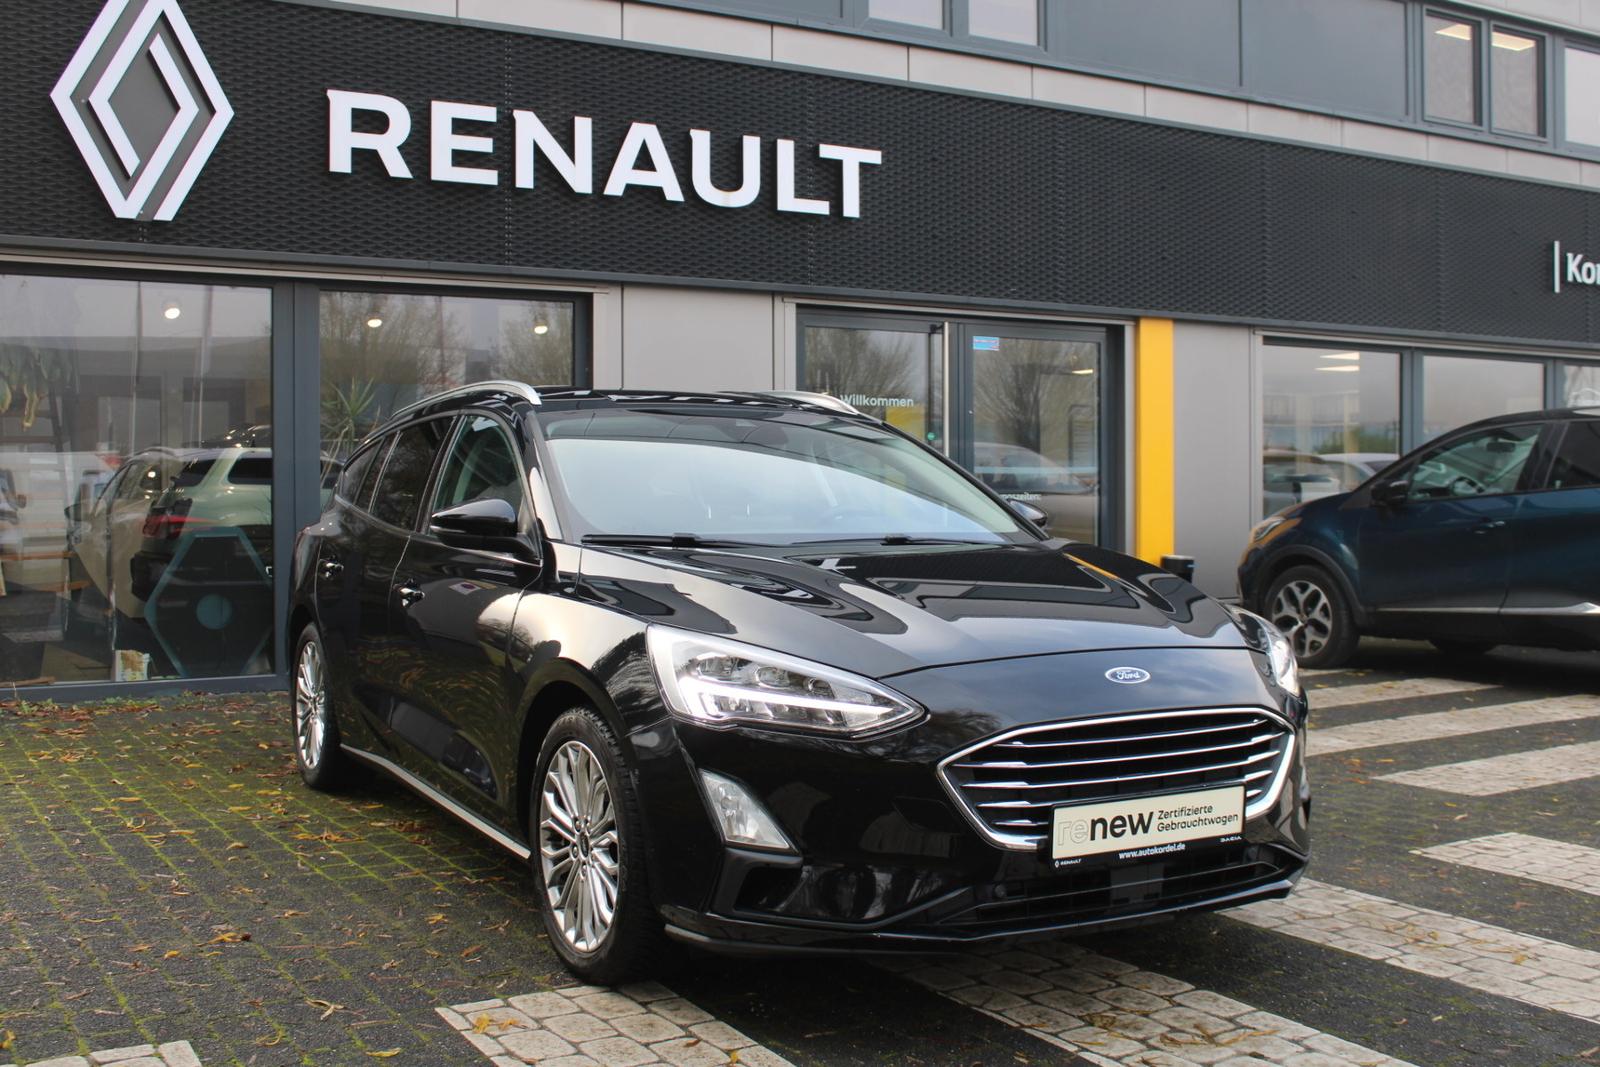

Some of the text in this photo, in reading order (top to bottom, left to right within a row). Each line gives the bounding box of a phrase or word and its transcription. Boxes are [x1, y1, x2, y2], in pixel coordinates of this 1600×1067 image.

[326, 88, 883, 219] RENAULT
[840, 394, 915, 407] Willkommen
[1157, 804, 1214, 820] Zertifizierte
[1057, 811, 1154, 846] renew
[1157, 814, 1239, 832] Gebrauchtwagen
[1119, 842, 1186, 859] www.autokordel.de
